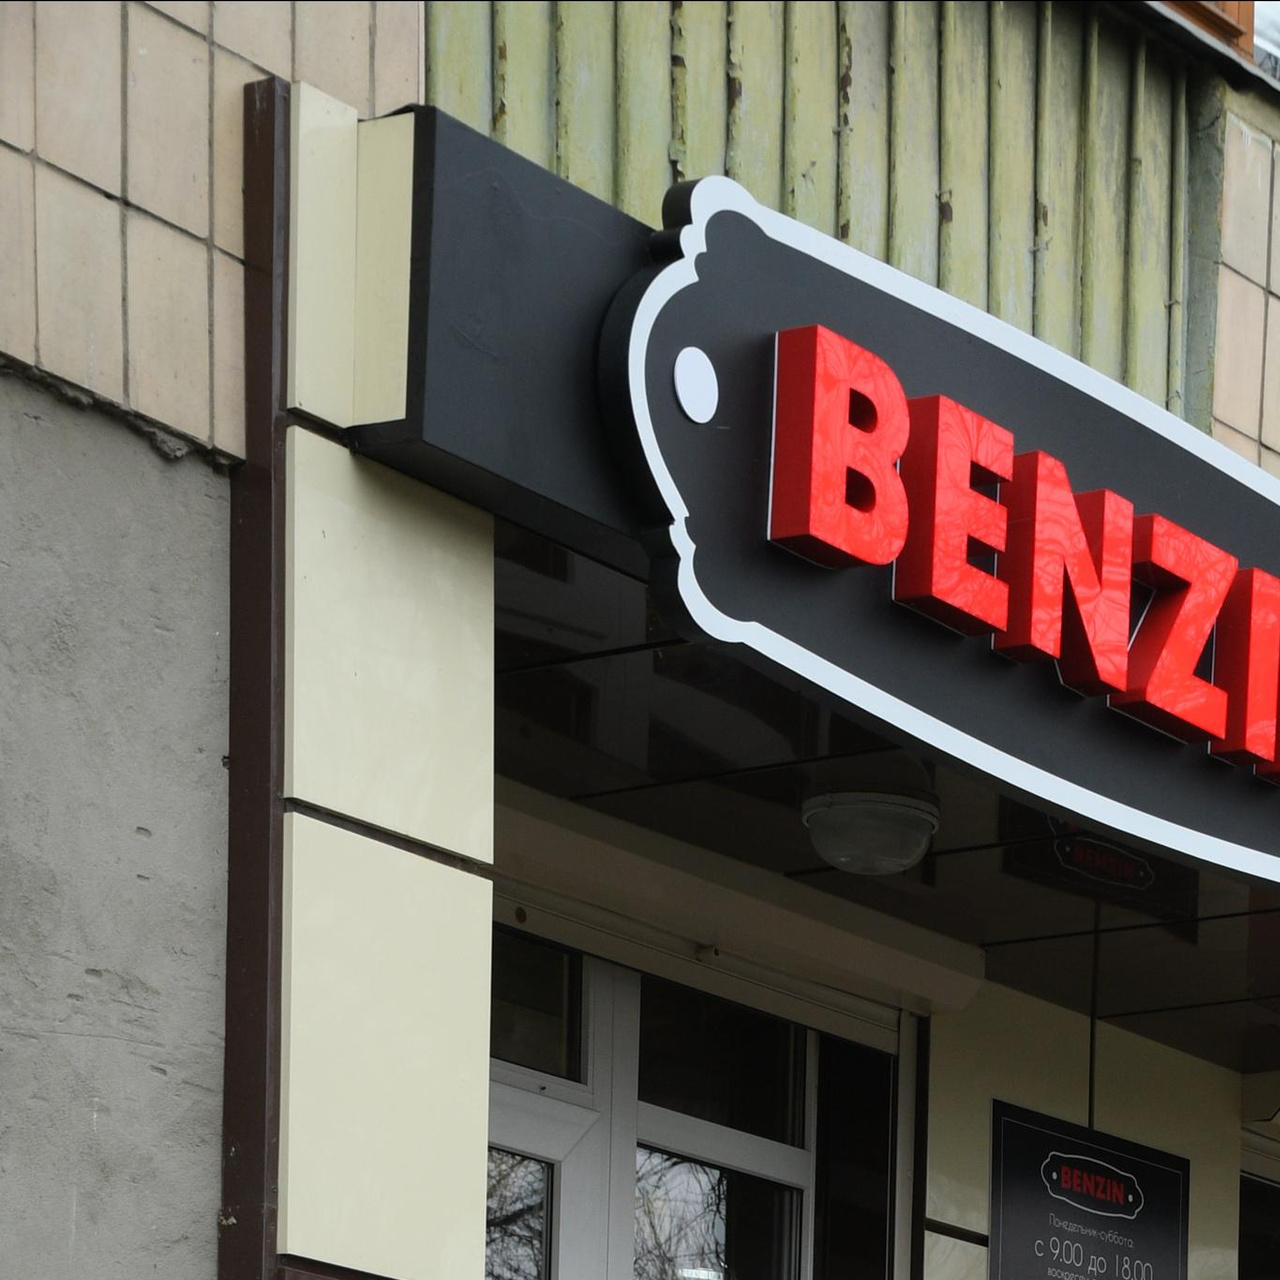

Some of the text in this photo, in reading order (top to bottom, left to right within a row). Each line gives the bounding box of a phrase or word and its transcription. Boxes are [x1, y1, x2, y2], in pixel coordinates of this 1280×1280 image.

[1060, 1165, 1125, 1205] BENZIN
[1050, 1236, 1083, 1267] 9.00
[1088, 1255, 1107, 1276] до
